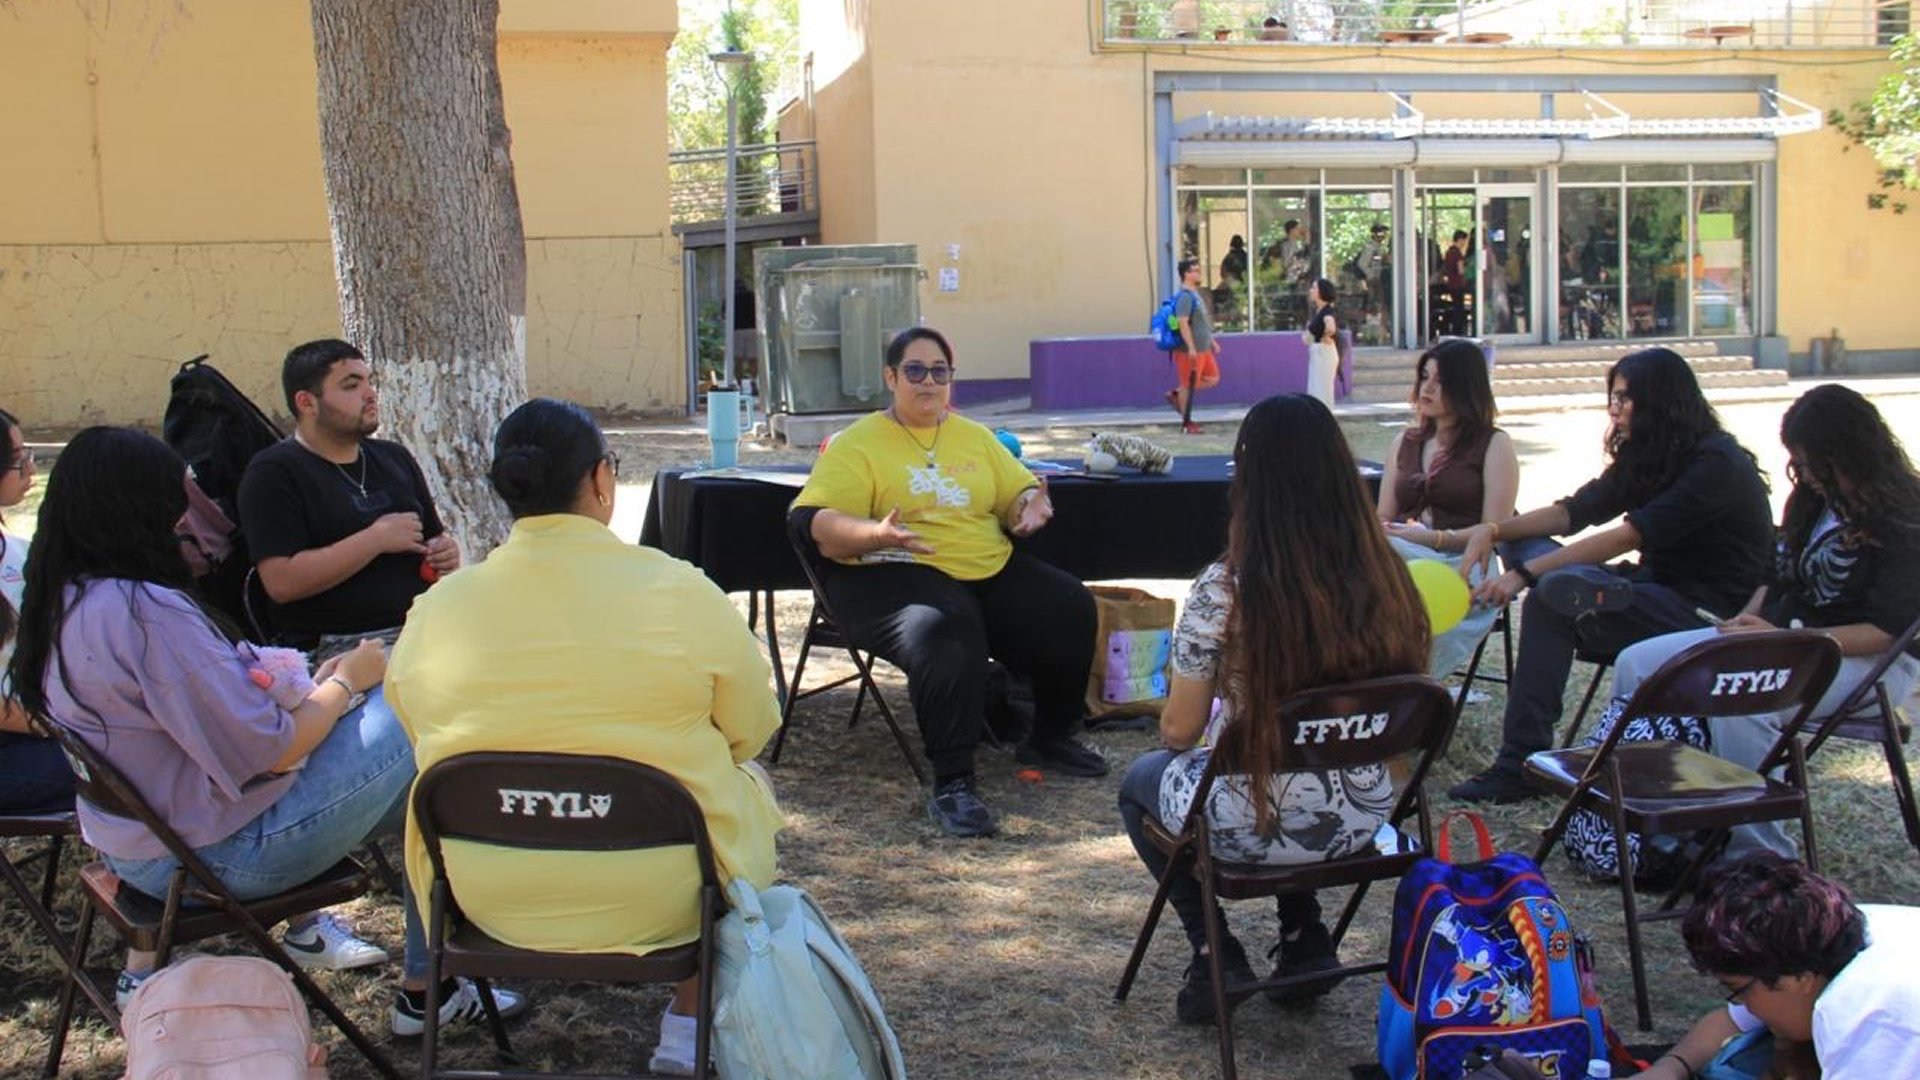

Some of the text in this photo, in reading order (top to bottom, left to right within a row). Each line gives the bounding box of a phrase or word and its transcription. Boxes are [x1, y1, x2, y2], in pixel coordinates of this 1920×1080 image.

[1711, 669, 1775, 695] FFYL
[1294, 714, 1372, 744] FFYL
[498, 789, 593, 818] FFYL
